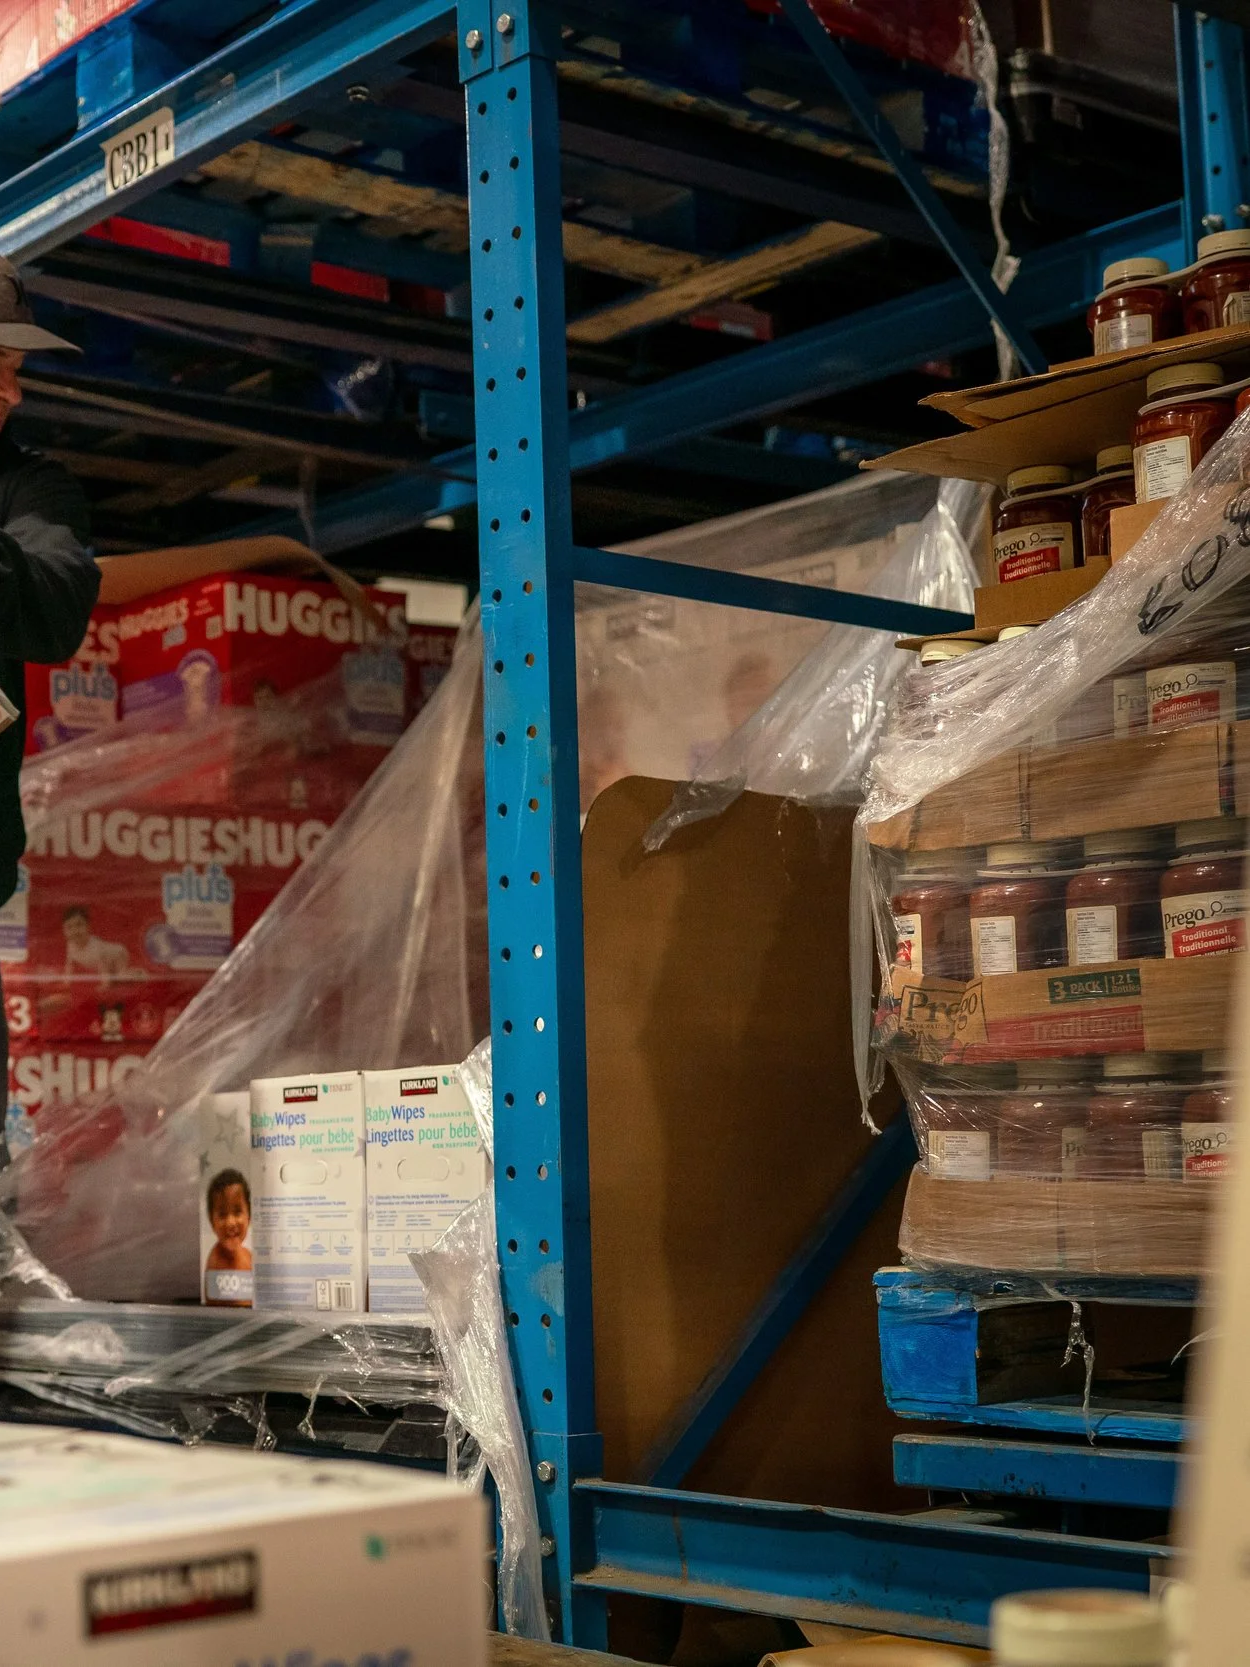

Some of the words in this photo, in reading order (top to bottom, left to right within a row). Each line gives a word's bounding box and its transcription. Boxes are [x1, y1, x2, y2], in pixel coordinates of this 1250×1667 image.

[993, 539, 1025, 561] Prego
[1004, 561, 1051, 580] Traditionnelle
[1006, 553, 1044, 570] Traditional
[52, 663, 117, 703] plus
[1159, 698, 1201, 715] Traditional
[165, 864, 233, 906] plus
[1164, 908, 1205, 929] Prego
[1182, 926, 1228, 942] Traditional
[1179, 935, 1237, 954] Traditionnelle
[1053, 981, 1067, 999] 3
[1070, 980, 1102, 995] PACK
[8, 995, 32, 1032] 3
[284, 1087, 317, 1098] KIRKLAND
[401, 1080, 437, 1091] KIRKLAND
[251, 1133, 296, 1152] Lingettes
[299, 1132, 324, 1149] pour
[328, 1128, 355, 1144] bébé
[366, 1128, 414, 1147] Lingettes
[418, 1127, 445, 1144] pour
[449, 1122, 478, 1139] bébé
